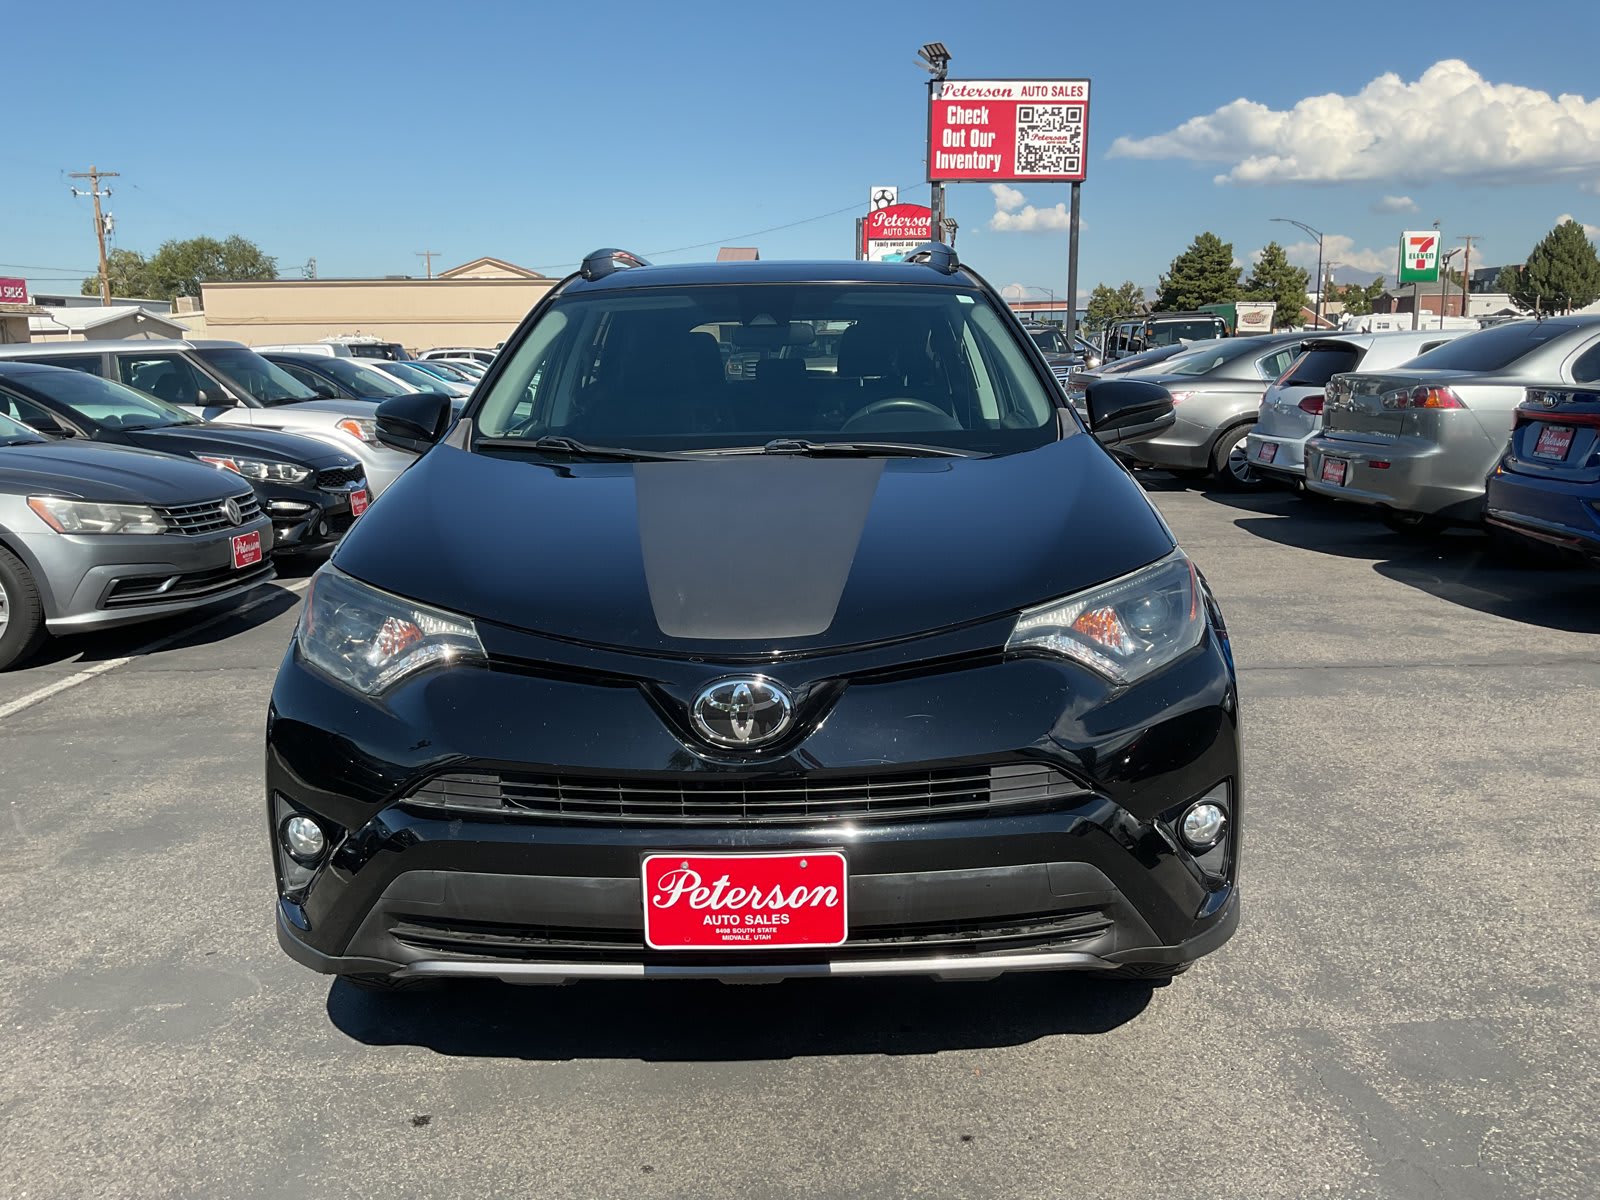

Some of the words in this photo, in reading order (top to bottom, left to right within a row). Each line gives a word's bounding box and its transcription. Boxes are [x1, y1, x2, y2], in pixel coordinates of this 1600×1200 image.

[941, 83, 1013, 98] Peterson
[1021, 86, 1048, 97] AUTO
[1051, 86, 1083, 97] SALES
[947, 105, 989, 125] Check
[943, 129, 966, 148] Out
[970, 129, 996, 148] Our
[1030, 133, 1068, 141] Peterson
[936, 150, 1002, 173] Inventory
[883, 228, 902, 236] AUTO
[904, 228, 927, 236] SALES
[1410, 237, 1434, 269] 7
[652, 869, 839, 910] Peterson
[703, 915, 740, 926] AUTO
[745, 914, 790, 925] SALES
